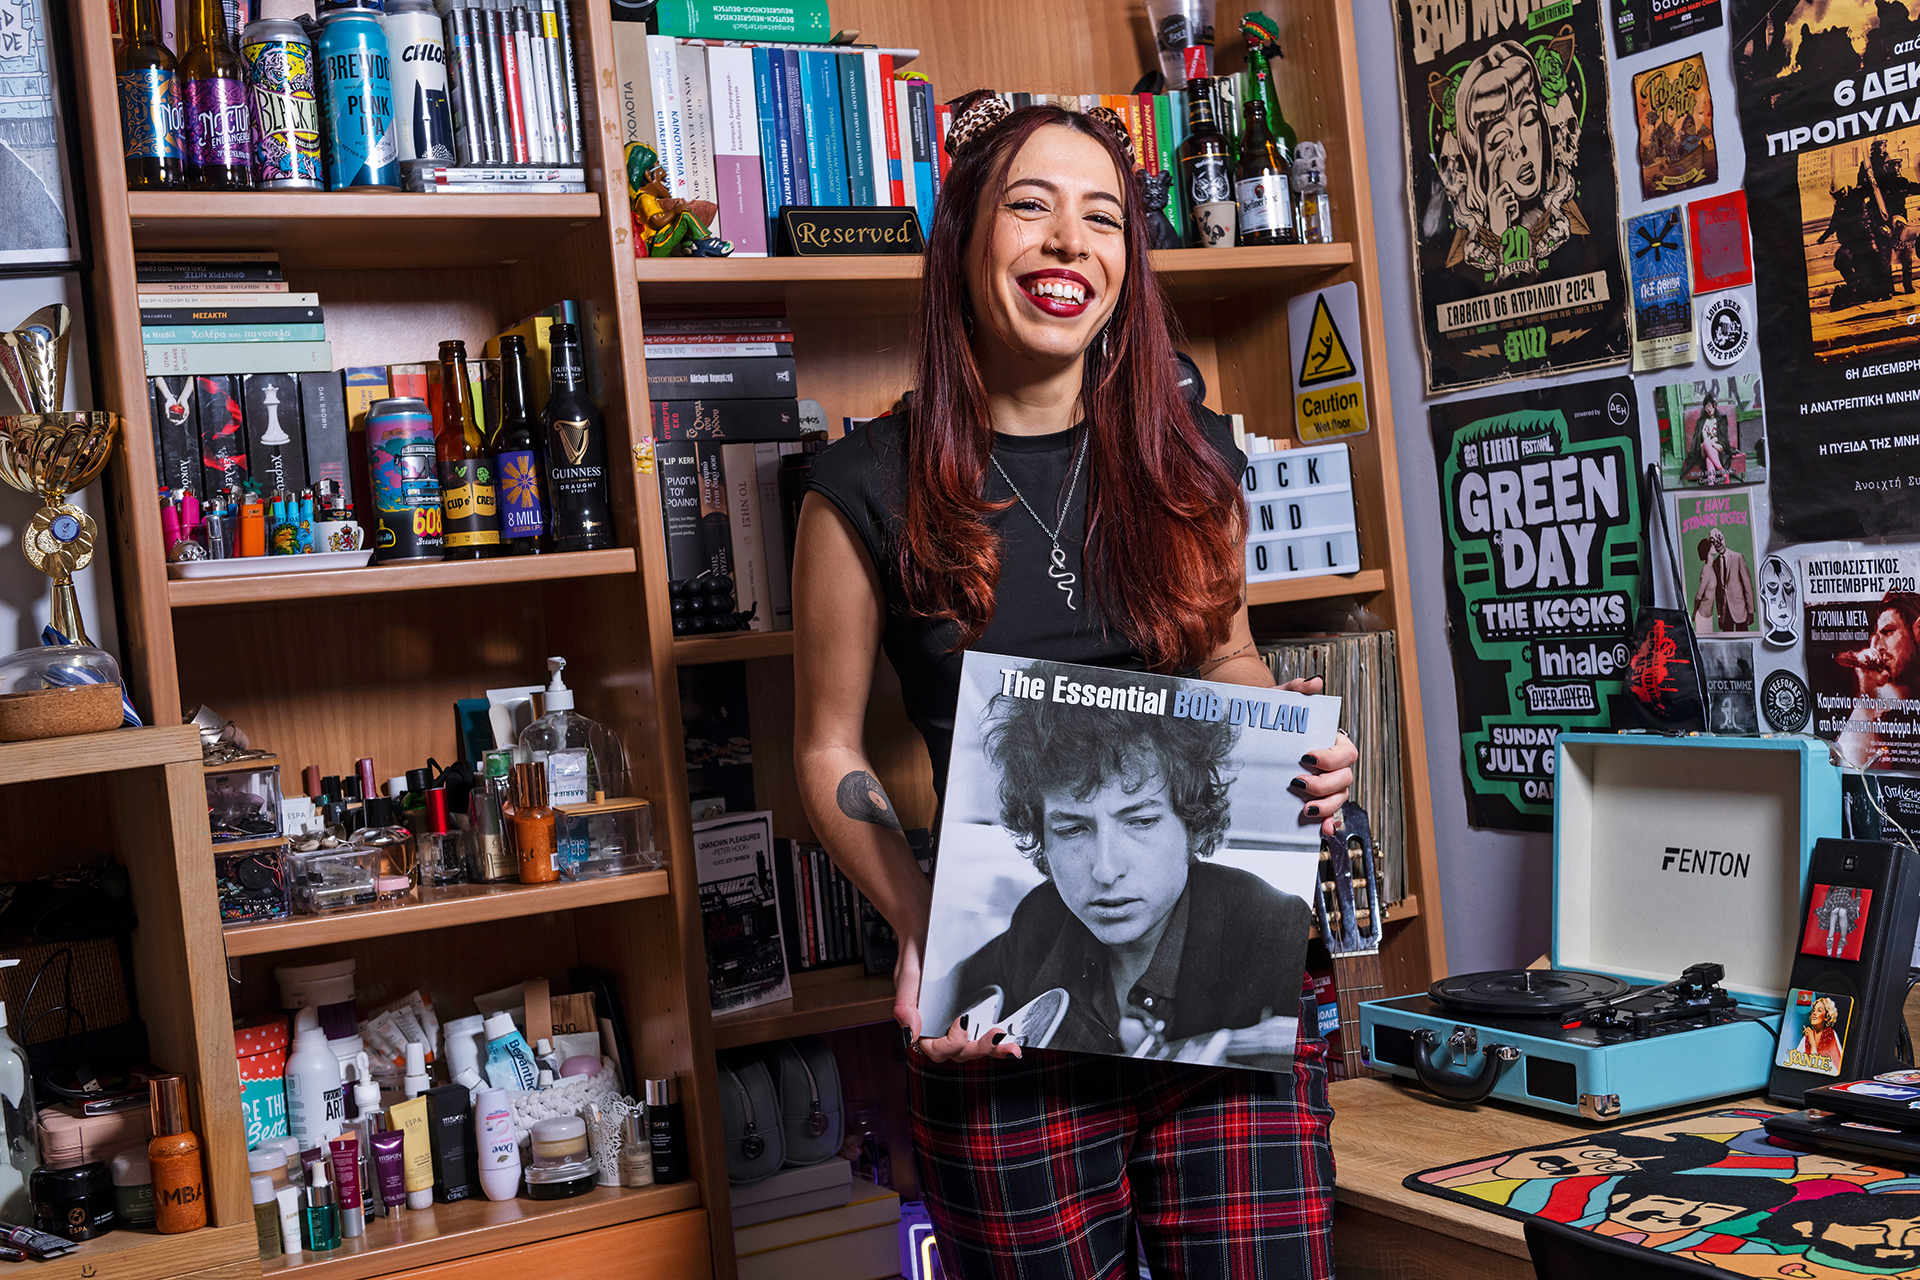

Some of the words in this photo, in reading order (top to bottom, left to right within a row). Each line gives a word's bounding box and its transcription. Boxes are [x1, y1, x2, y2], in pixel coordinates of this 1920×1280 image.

[713, 5, 794, 15] NEUGRIECHISCH-DEUTSCH
[714, 13, 795, 23] DEUTSCH-NEUGRIECHISCH
[1546, 2, 1570, 20] FRIENDS
[1676, 6, 1687, 16] AND
[1687, 3, 1701, 13] MARY
[733, 22, 795, 31] Kompaktwörterbuch
[1410, 0, 1466, 64] BAD
[1641, 62, 1703, 110] Pirates
[1833, 79, 1856, 107] 6
[348, 95, 390, 116] PUNK
[1657, 88, 1698, 127] City
[360, 116, 385, 137] IPA
[805, 103, 815, 137] Phonologie
[671, 110, 684, 176] ΚΑΙΝΟΤΟΜΙΑ
[780, 139, 790, 175] ΓΕΝΕΤΙΚΗ
[808, 142, 817, 169] Phonetik
[797, 219, 912, 248] Reserved
[1501, 228, 1529, 265] 20
[1507, 262, 1528, 273] YEARS
[1446, 299, 1492, 328] ΣΑΒΒΑΤΟ
[1495, 296, 1508, 316] 06
[1511, 284, 1562, 314] ΑΠΡΙΛΙΟΥ
[1565, 276, 1596, 301] 2024
[1706, 300, 1723, 321] LOVE
[1723, 299, 1742, 314] BEER
[192, 312, 228, 320] ΜΕΣΑΚΤΗ
[191, 329, 226, 340] Χολέρα
[244, 328, 291, 339] πανούκλα
[1504, 326, 1548, 363] FUZZ
[1706, 341, 1723, 359] HATE
[1724, 331, 1749, 360] FASCISM
[1845, 367, 1860, 381] 6Η
[317, 386, 326, 402] DAN
[1302, 389, 1358, 418] Caution
[1574, 410, 1594, 418] powered
[1610, 402, 1627, 415] ΔΕΗ
[1800, 404, 1808, 415] Η
[1810, 394, 1884, 414] ΑΝΑΤΡΕΠΤΙΚΗ
[319, 403, 328, 429] BROWN
[662, 401, 672, 440] ΟΥΜΠΕΡΤΟ
[672, 412, 680, 429] ΕΚΟ
[1314, 419, 1332, 435] Wet
[1331, 416, 1350, 432] floor
[1521, 435, 1554, 455] FESTIVAL
[1819, 444, 1828, 456] Η
[1829, 440, 1868, 455] ΠΥΞΙΔΑ
[1869, 437, 1892, 450] ΤΗΣ
[678, 457, 695, 465] KERR
[552, 466, 602, 480] GUINNESS
[560, 482, 597, 491] DRAUGHT
[670, 487, 685, 497] ΤΟΥ
[738, 480, 748, 497] ΤΟ
[1854, 476, 1902, 491] Ανοιχτή
[1459, 455, 1619, 533] GREEN
[447, 498, 463, 510] CUP
[740, 499, 752, 528] ΝΗΣΙ
[1695, 500, 1701, 514] I
[1704, 497, 1731, 512] HAVE
[508, 511, 514, 526] 8
[516, 510, 549, 526] MILLS
[1682, 513, 1718, 533] STRANGE
[1719, 510, 1748, 526] TASTES!
[1502, 523, 1597, 589] DAY
[1808, 558, 1900, 577] ΑΝΤΙΦΑΣΙΣΤΙΚΟΣ
[1810, 577, 1886, 594] ΣΕΠΤΕΜΒΡΗΣ
[1888, 577, 1916, 593] 2020
[1482, 600, 1529, 630] THE
[1534, 595, 1625, 627] KOOKS
[1811, 611, 1816, 627] 7
[1817, 610, 1845, 627] ΧΡΟΝΙΑ
[1846, 610, 1869, 627] ΜΕΤΑ
[1729, 679, 1752, 691] ΤΙΜΗΣ
[1000, 669, 1045, 701] The
[1052, 676, 1168, 717] Essential
[1172, 690, 1223, 723] BOB
[1228, 697, 1309, 734] DYLAN
[1531, 685, 1591, 709] OVERJOYED
[1816, 692, 1851, 713] Καμπάνια
[1852, 693, 1887, 714] συλλογής
[1493, 727, 1558, 746] SUNDAY
[1872, 716, 1911, 738] πλατφόρμα
[1486, 749, 1537, 774] JULY
[1524, 780, 1553, 799] OA
[287, 811, 306, 822] ESPA
[698, 837, 729, 850] UNKNOWN
[728, 832, 761, 845] PLEASURES
[712, 858, 726, 866] INSIDE
[733, 854, 750, 863] DIVISION
[1661, 846, 1751, 878] FENTON
[325, 1103, 343, 1121] ART
[404, 1116, 423, 1128] ESPA
[491, 1142, 514, 1153] Dove
[69, 1226, 88, 1235] ESPA
